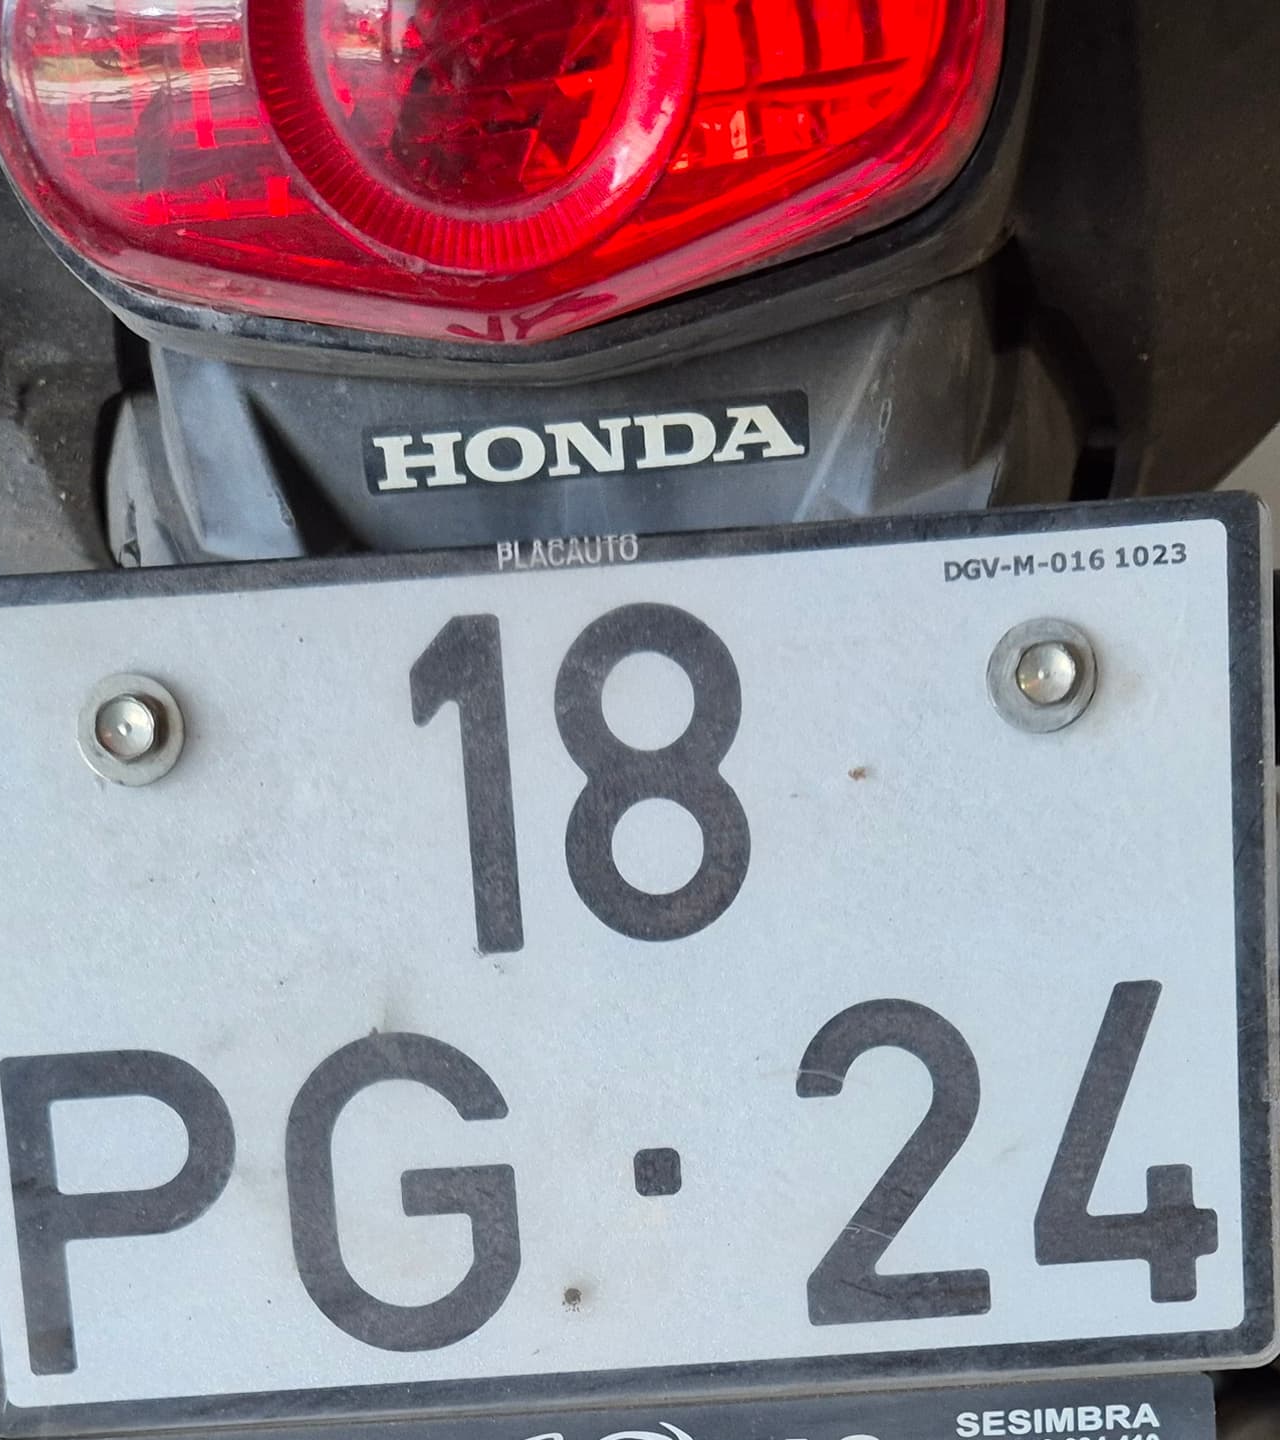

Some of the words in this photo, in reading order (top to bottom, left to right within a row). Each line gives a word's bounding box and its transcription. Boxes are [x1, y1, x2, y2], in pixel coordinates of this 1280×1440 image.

[372, 403, 806, 490] HONDA
[496, 533, 639, 571] PLACAUTO
[943, 548, 1106, 583] DGV-M-016
[1115, 542, 1188, 569] 1023
[408, 602, 752, 956] 18
[795, 979, 1219, 1327] 24
[955, 1403, 1161, 1438] SESIMBRA
